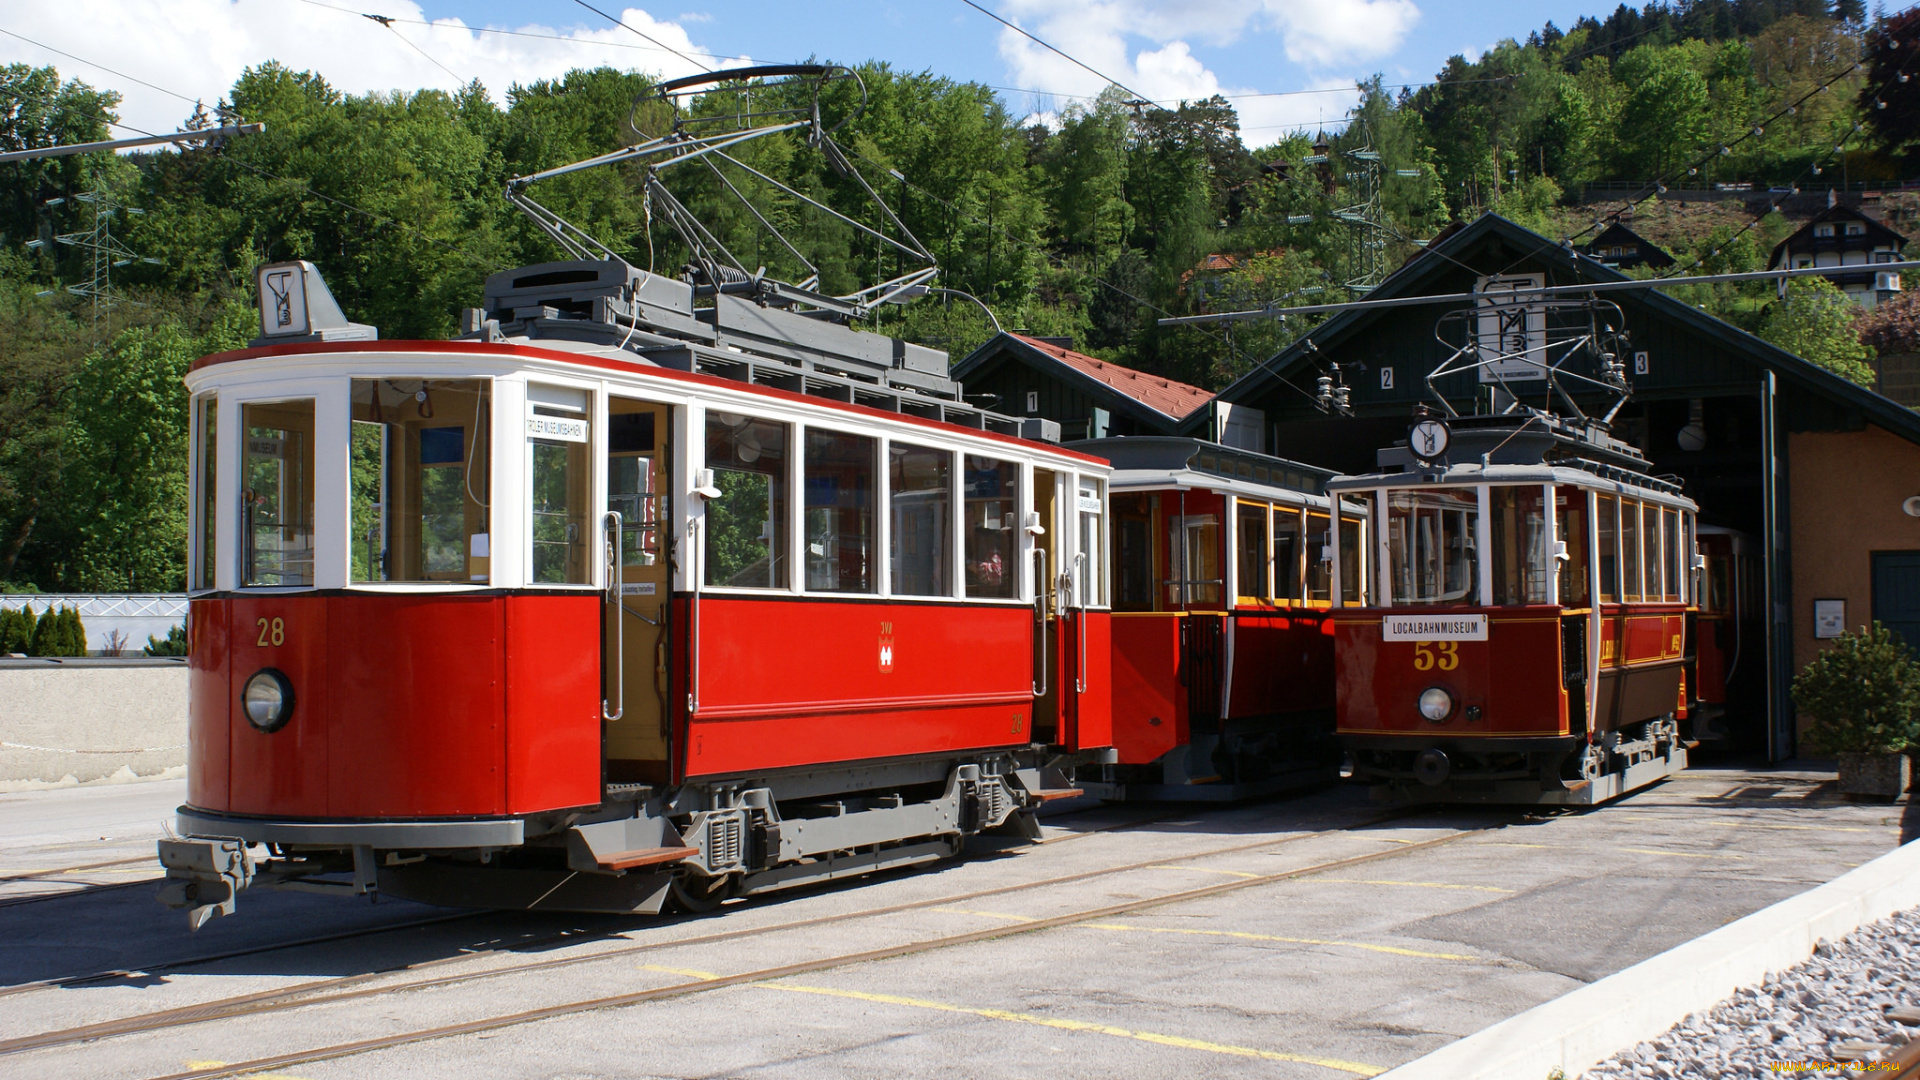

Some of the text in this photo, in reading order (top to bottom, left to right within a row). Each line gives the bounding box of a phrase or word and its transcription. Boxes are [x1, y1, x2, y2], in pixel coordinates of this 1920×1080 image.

[1637, 354, 1646, 372] 3
[1383, 370, 1391, 387] 2
[1029, 394, 1035, 410] 1
[257, 617, 285, 647] 28
[1392, 621, 1478, 635] LOCALBAHNMUSEUM
[1413, 641, 1460, 671] 53
[1011, 713, 1023, 734] 28
